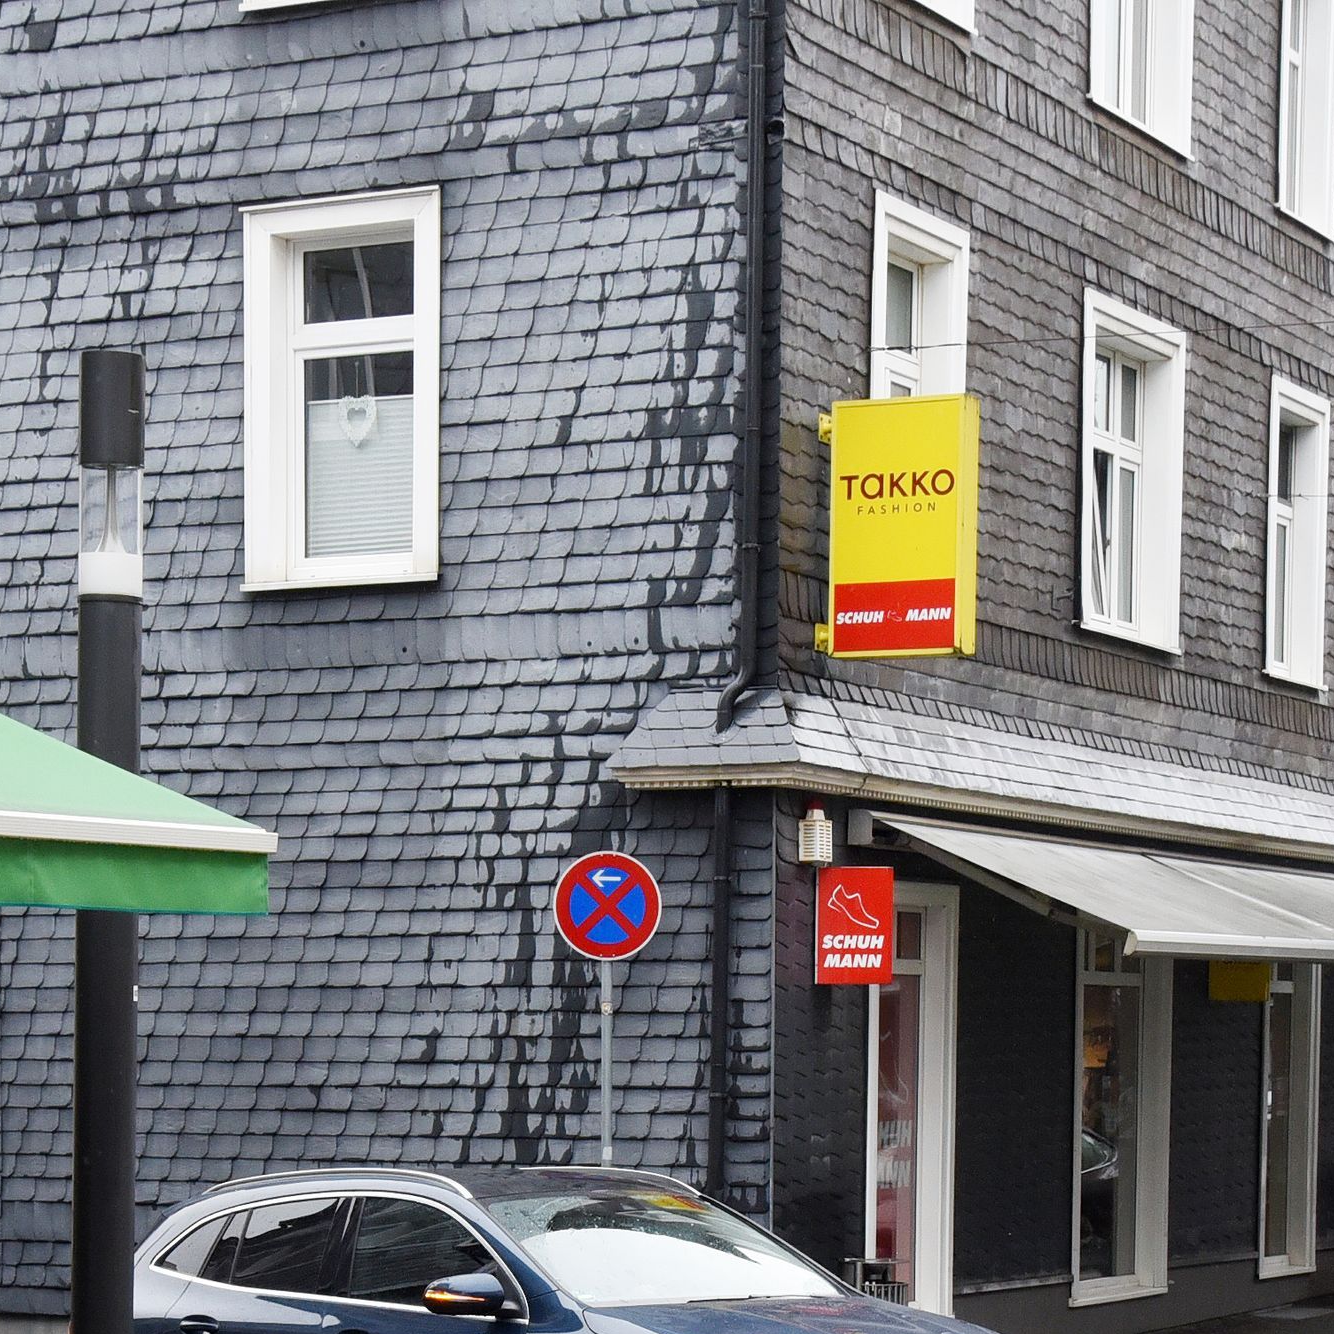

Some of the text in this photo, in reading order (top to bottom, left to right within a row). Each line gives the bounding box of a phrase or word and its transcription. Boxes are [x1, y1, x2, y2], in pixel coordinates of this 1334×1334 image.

[857, 502, 937, 516] FASHION
[836, 607, 952, 625] SCHUH MANN
[822, 934, 885, 950] SCHUH
[823, 953, 883, 969] MANN
